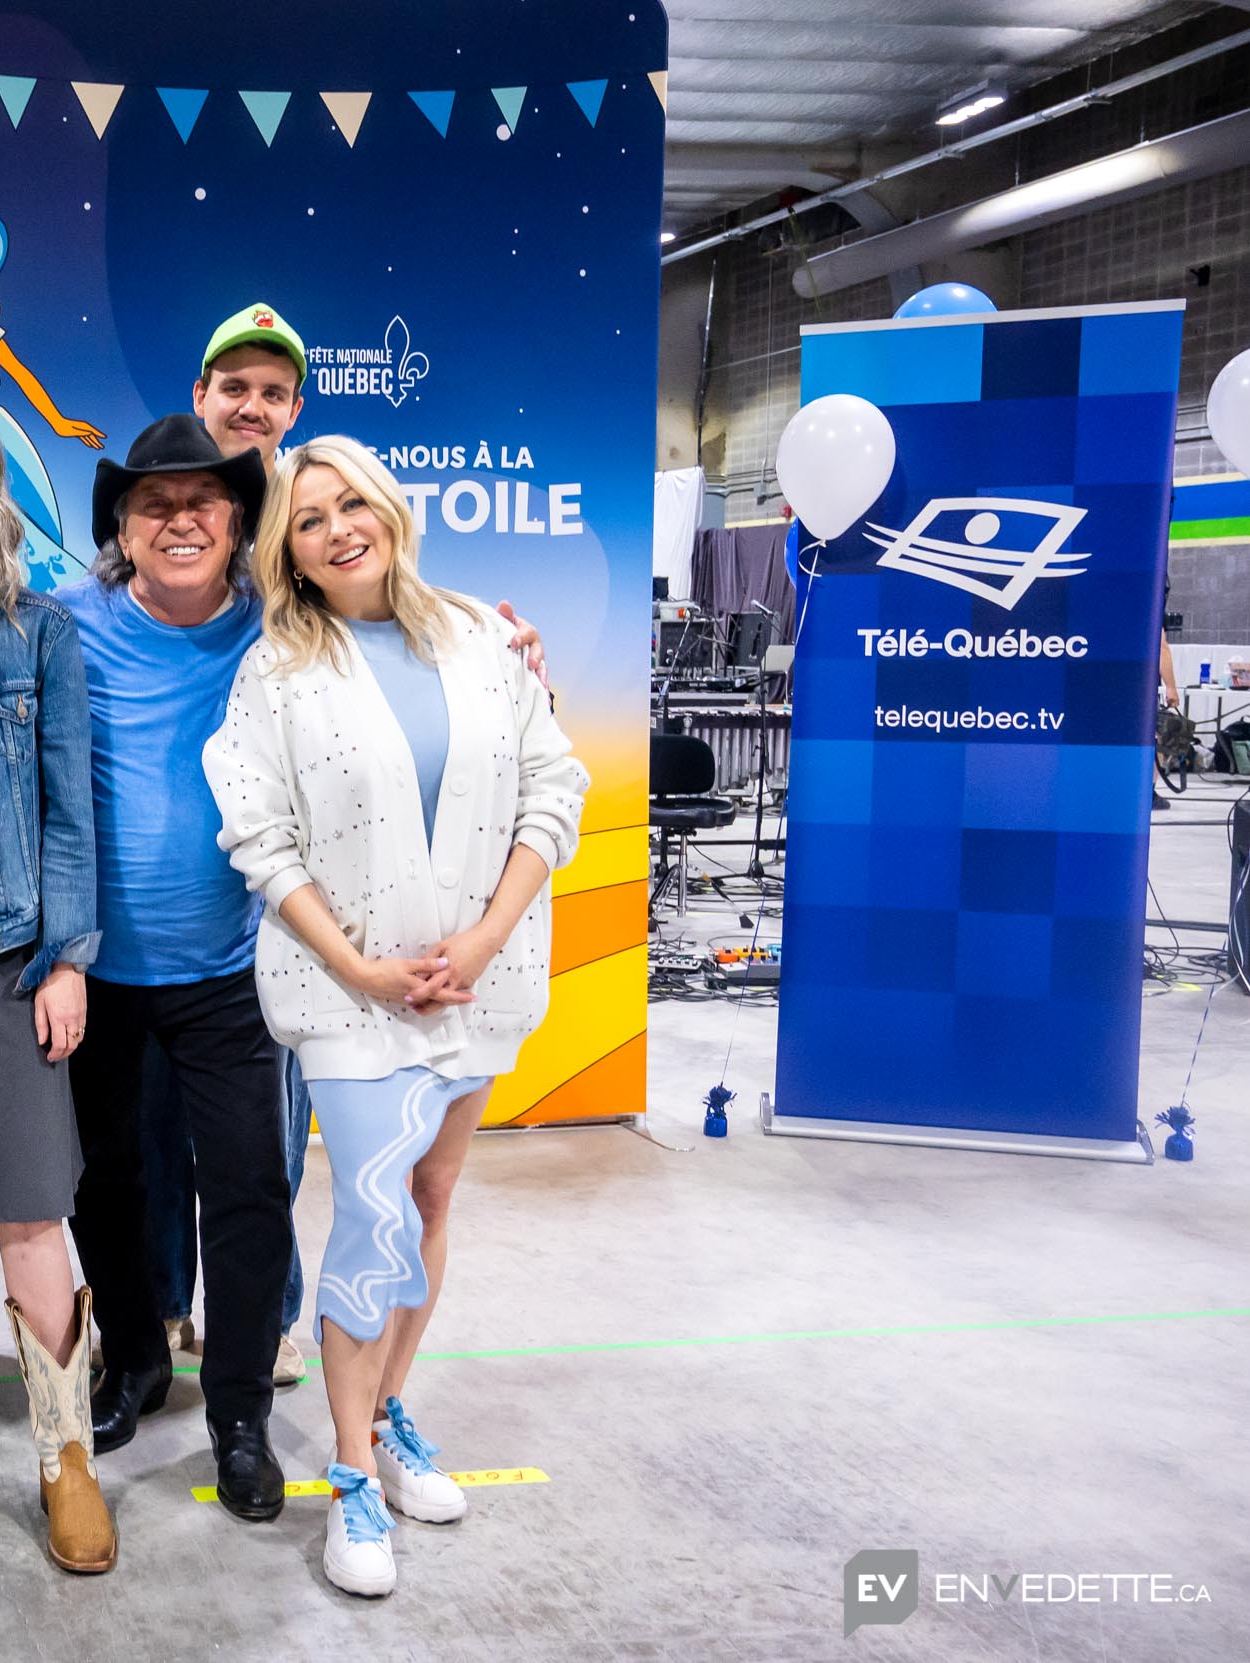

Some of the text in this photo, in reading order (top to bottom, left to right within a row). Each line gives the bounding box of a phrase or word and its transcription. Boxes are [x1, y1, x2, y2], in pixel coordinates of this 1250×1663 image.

[310, 346, 334, 364] FÊTE
[336, 348, 393, 365] NATIONALE
[317, 363, 394, 395] QUÉBEC
[473, 440, 493, 469] À
[501, 447, 534, 469] LA
[401, 479, 584, 536] TOILE
[857, 628, 1088, 659] Télé-Québec
[874, 704, 1065, 733] telequebec.tv
